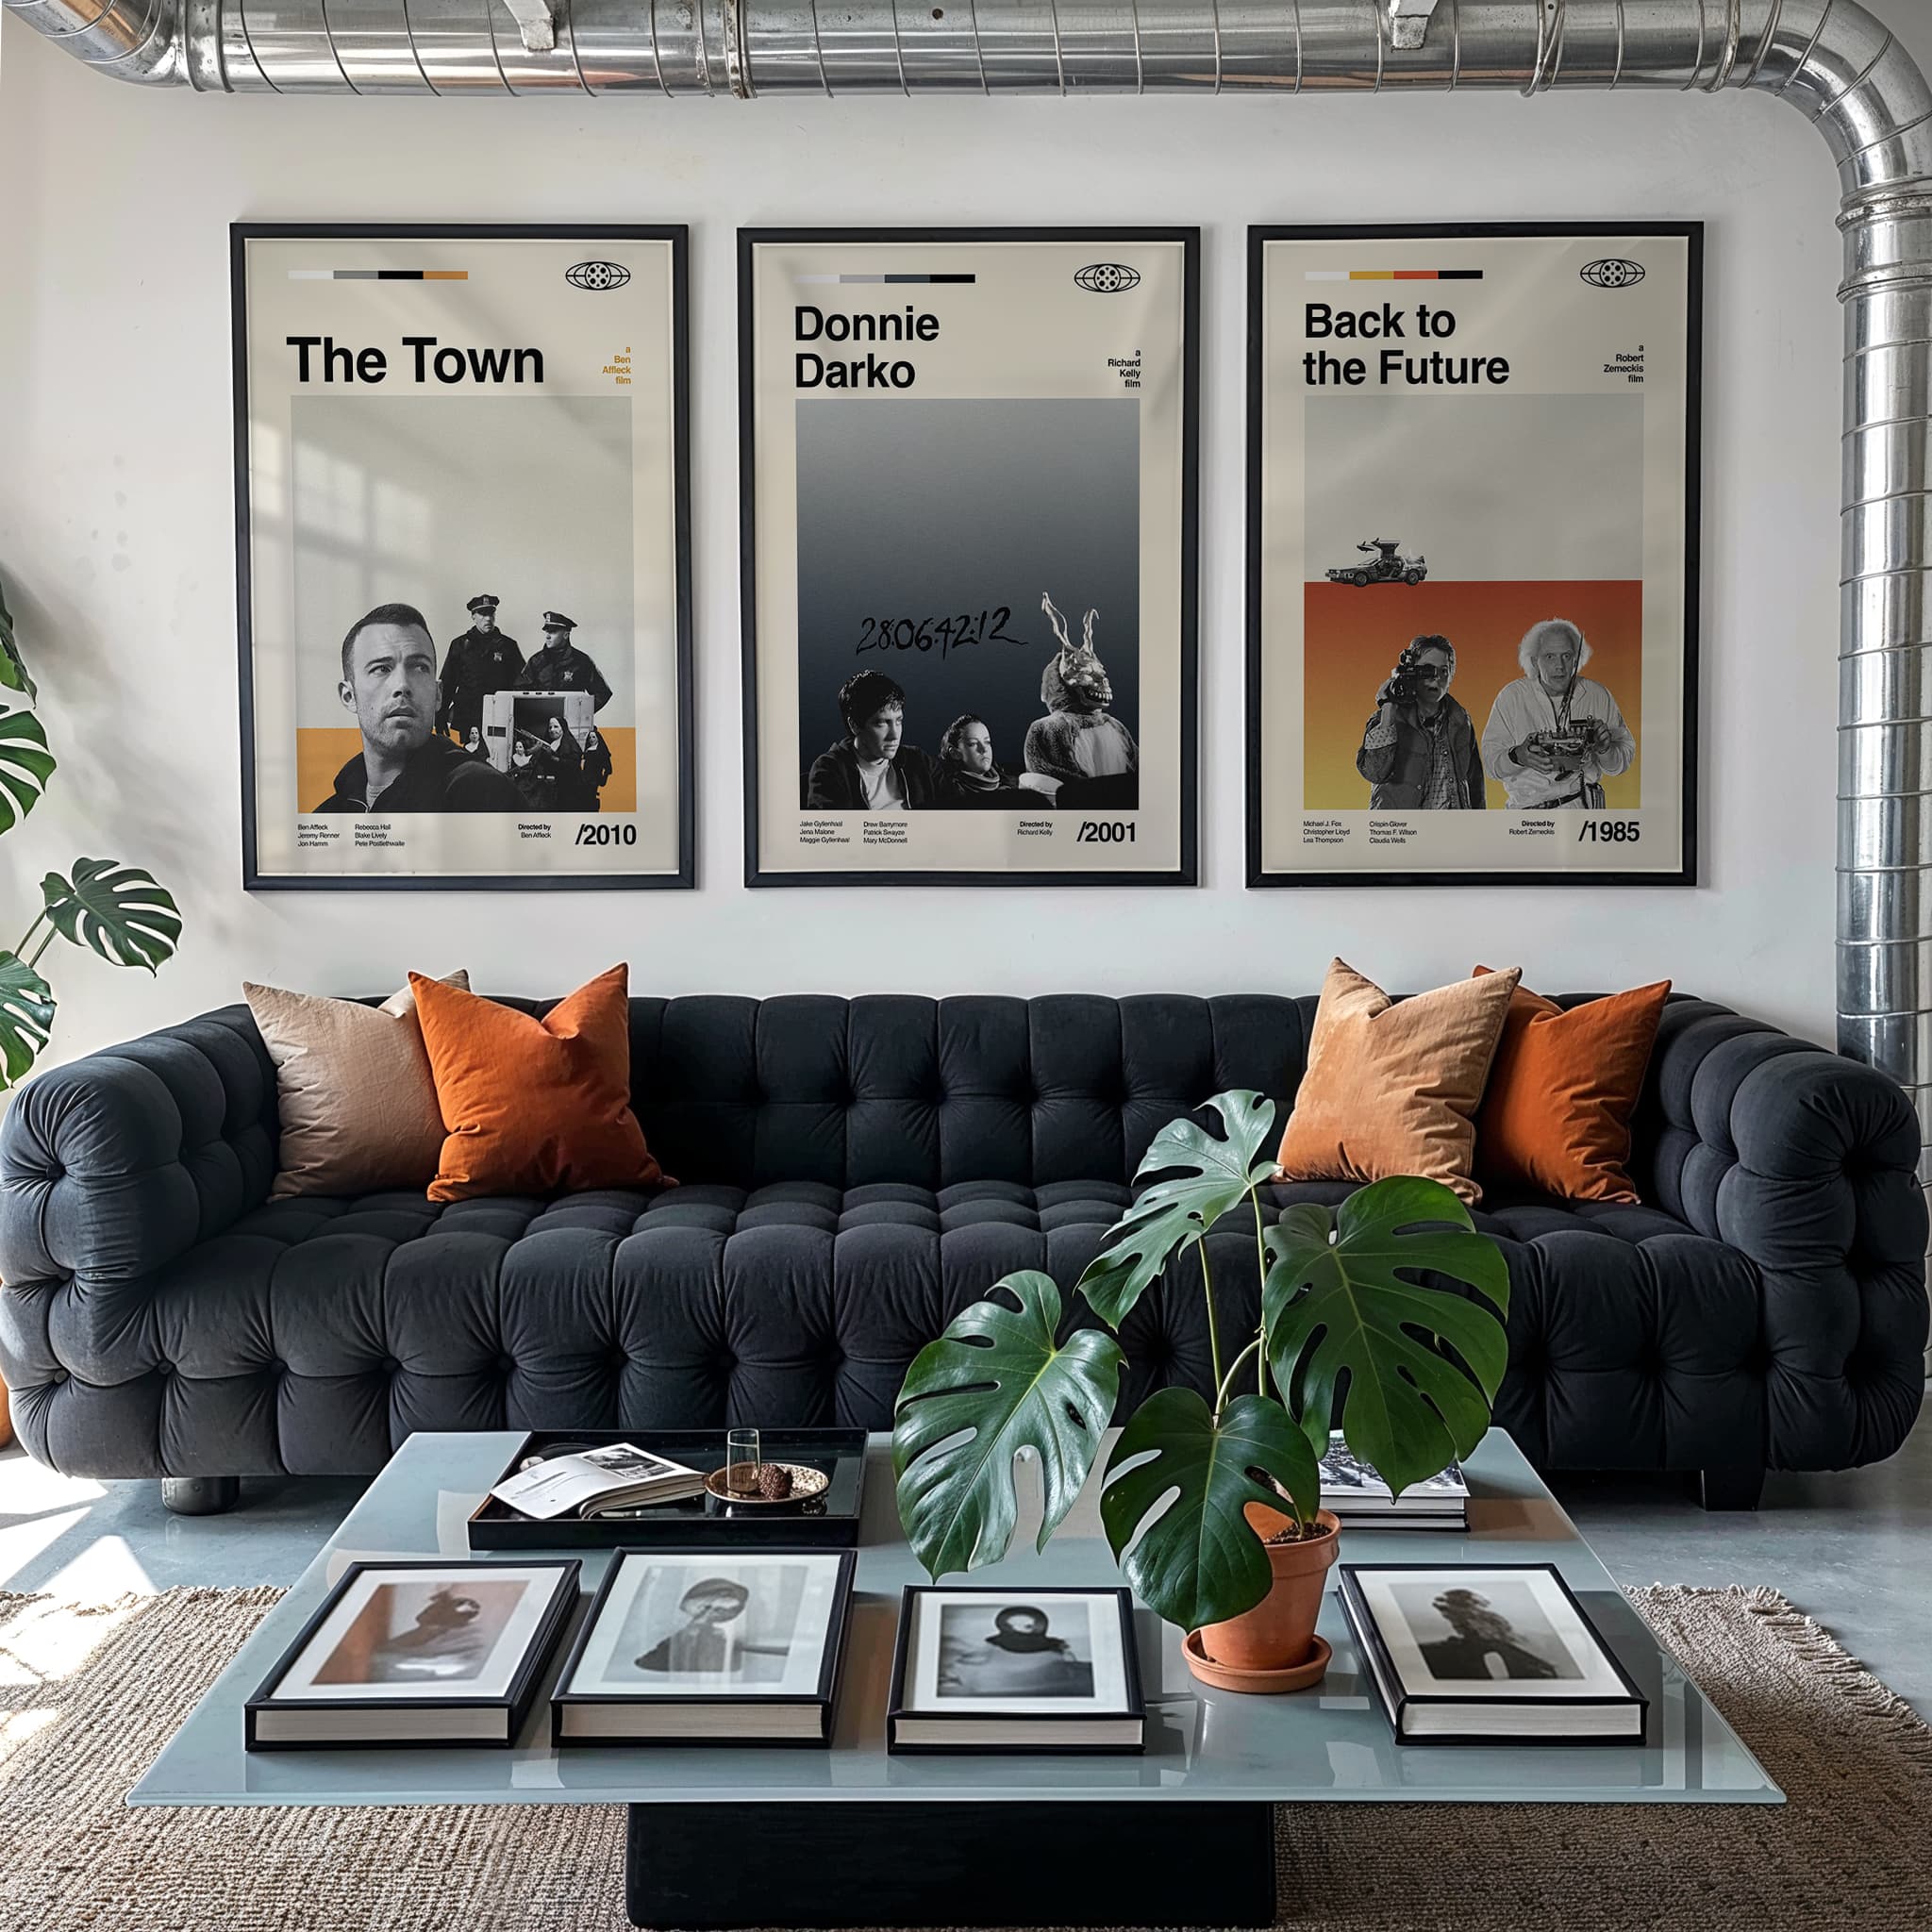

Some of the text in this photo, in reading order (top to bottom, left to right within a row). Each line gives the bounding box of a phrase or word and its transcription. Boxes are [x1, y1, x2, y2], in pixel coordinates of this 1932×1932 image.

[795, 306, 940, 341] Donnie
[1306, 303, 1456, 338] Back to
[286, 337, 544, 384] The Town
[614, 355, 631, 363] Ben
[1108, 358, 1141, 367] Richard
[1615, 353, 1644, 362] Robert
[603, 365, 631, 375] Affleck
[796, 353, 915, 388] Darko
[1303, 349, 1509, 385] the Future
[1603, 363, 1644, 373] Zemeckis
[1119, 369, 1141, 379] Kelly
[1628, 374, 1644, 383] film
[615, 375, 631, 384] film
[1124, 379, 1141, 388] film
[542, 824, 552, 832] by
[1546, 820, 1556, 828] by
[575, 824, 637, 845] /2010
[1076, 822, 1136, 842] /2001
[1578, 820, 1641, 842] /1985
